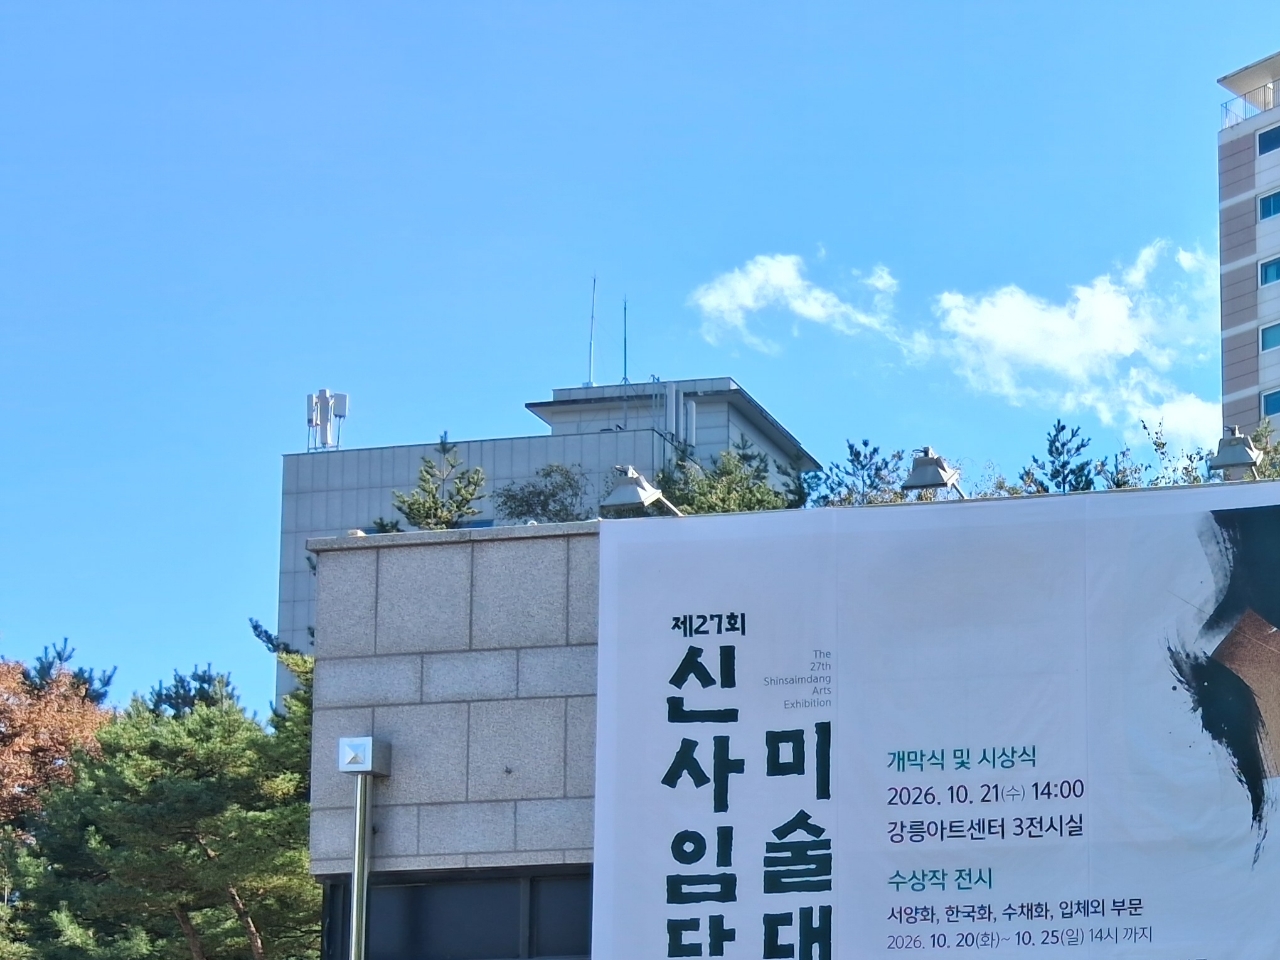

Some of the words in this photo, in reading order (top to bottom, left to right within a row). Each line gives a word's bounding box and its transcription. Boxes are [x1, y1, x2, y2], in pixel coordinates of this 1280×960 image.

[671, 612, 746, 637] 제27회
[813, 650, 831, 659] The
[810, 662, 831, 671] 27th
[763, 674, 831, 686] Shinsaimdang
[812, 686, 831, 695] Arts
[784, 699, 831, 709] Exhibition
[887, 749, 945, 772] 개막식
[953, 748, 971, 770] 및
[978, 745, 1036, 769] 시상식
[887, 786, 941, 806] 2026.
[947, 784, 974, 804] 10.
[980, 783, 1026, 803] 21(수)
[1031, 779, 1085, 800] 14:00
[887, 817, 1005, 843] 강릉아트센터
[1012, 813, 1083, 838] 3전시실
[888, 869, 948, 892] 수상작
[954, 868, 992, 890] 전시
[887, 905, 940, 925] 서양화,
[945, 904, 997, 923] 한국화,
[1002, 902, 1054, 921] 수채화,
[1059, 899, 1105, 919] 입체외
[1111, 898, 1143, 917] 부문
[887, 935, 925, 949] 2026.
[930, 933, 951, 948] 10.
[1015, 931, 1035, 946] 10.
[1041, 928, 1085, 946] 25(일)
[1089, 926, 1118, 944] 14시
[1122, 926, 1152, 943] 까지
